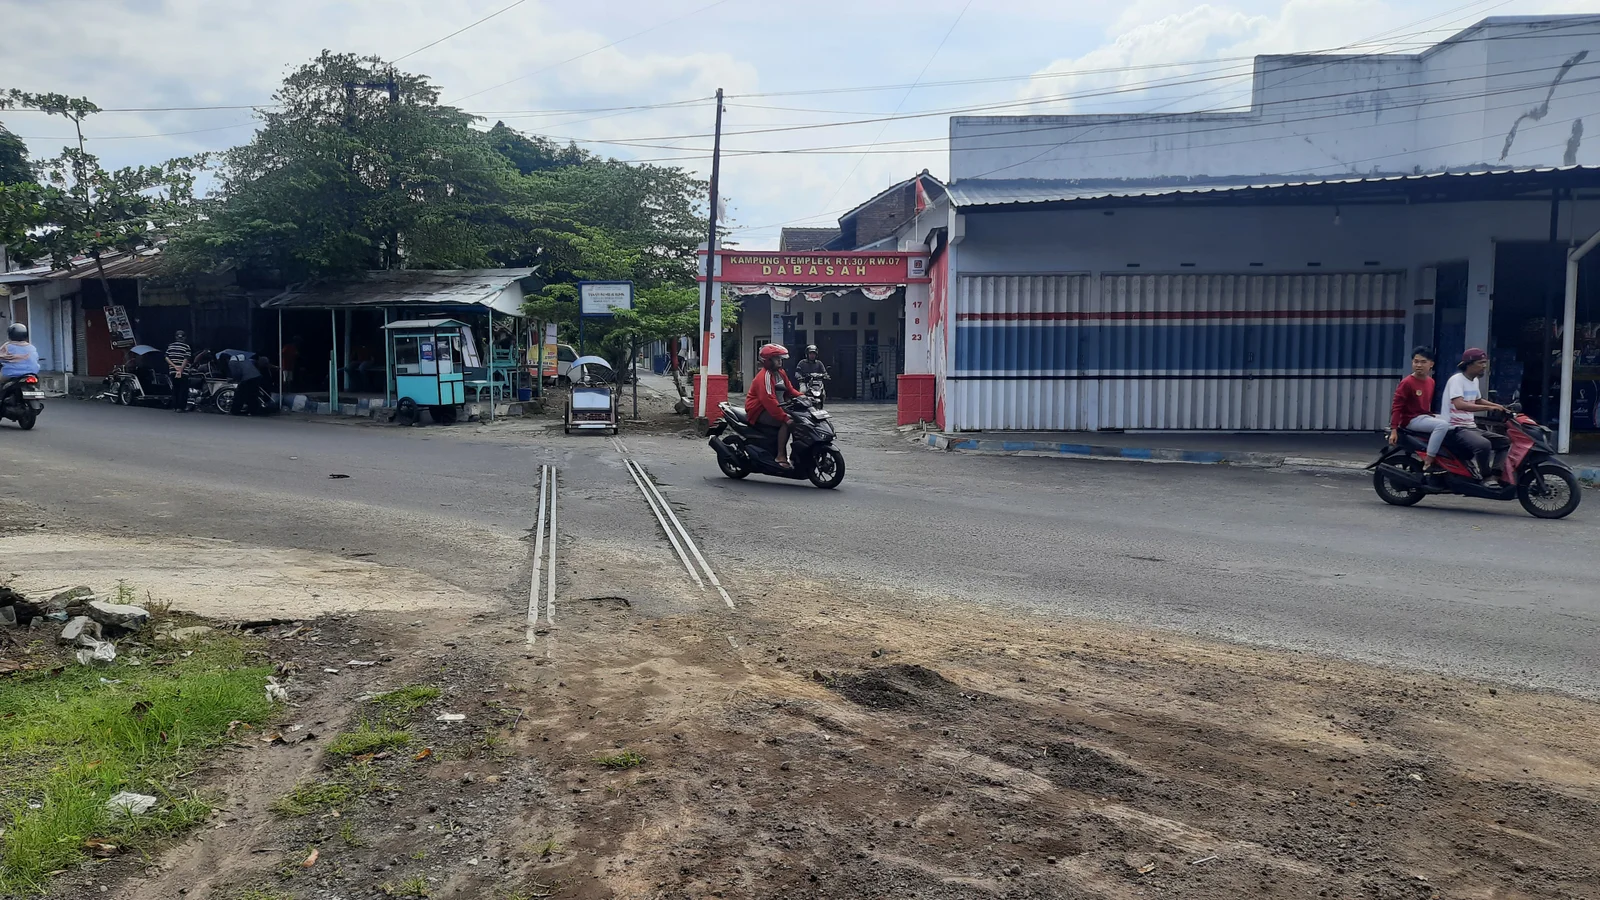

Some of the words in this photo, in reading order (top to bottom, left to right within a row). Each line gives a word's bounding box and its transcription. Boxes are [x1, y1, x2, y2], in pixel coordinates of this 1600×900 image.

[730, 256, 780, 265] KAMPUNG
[784, 256, 831, 265] TEMPLEK
[762, 265, 867, 276] DABASAH
